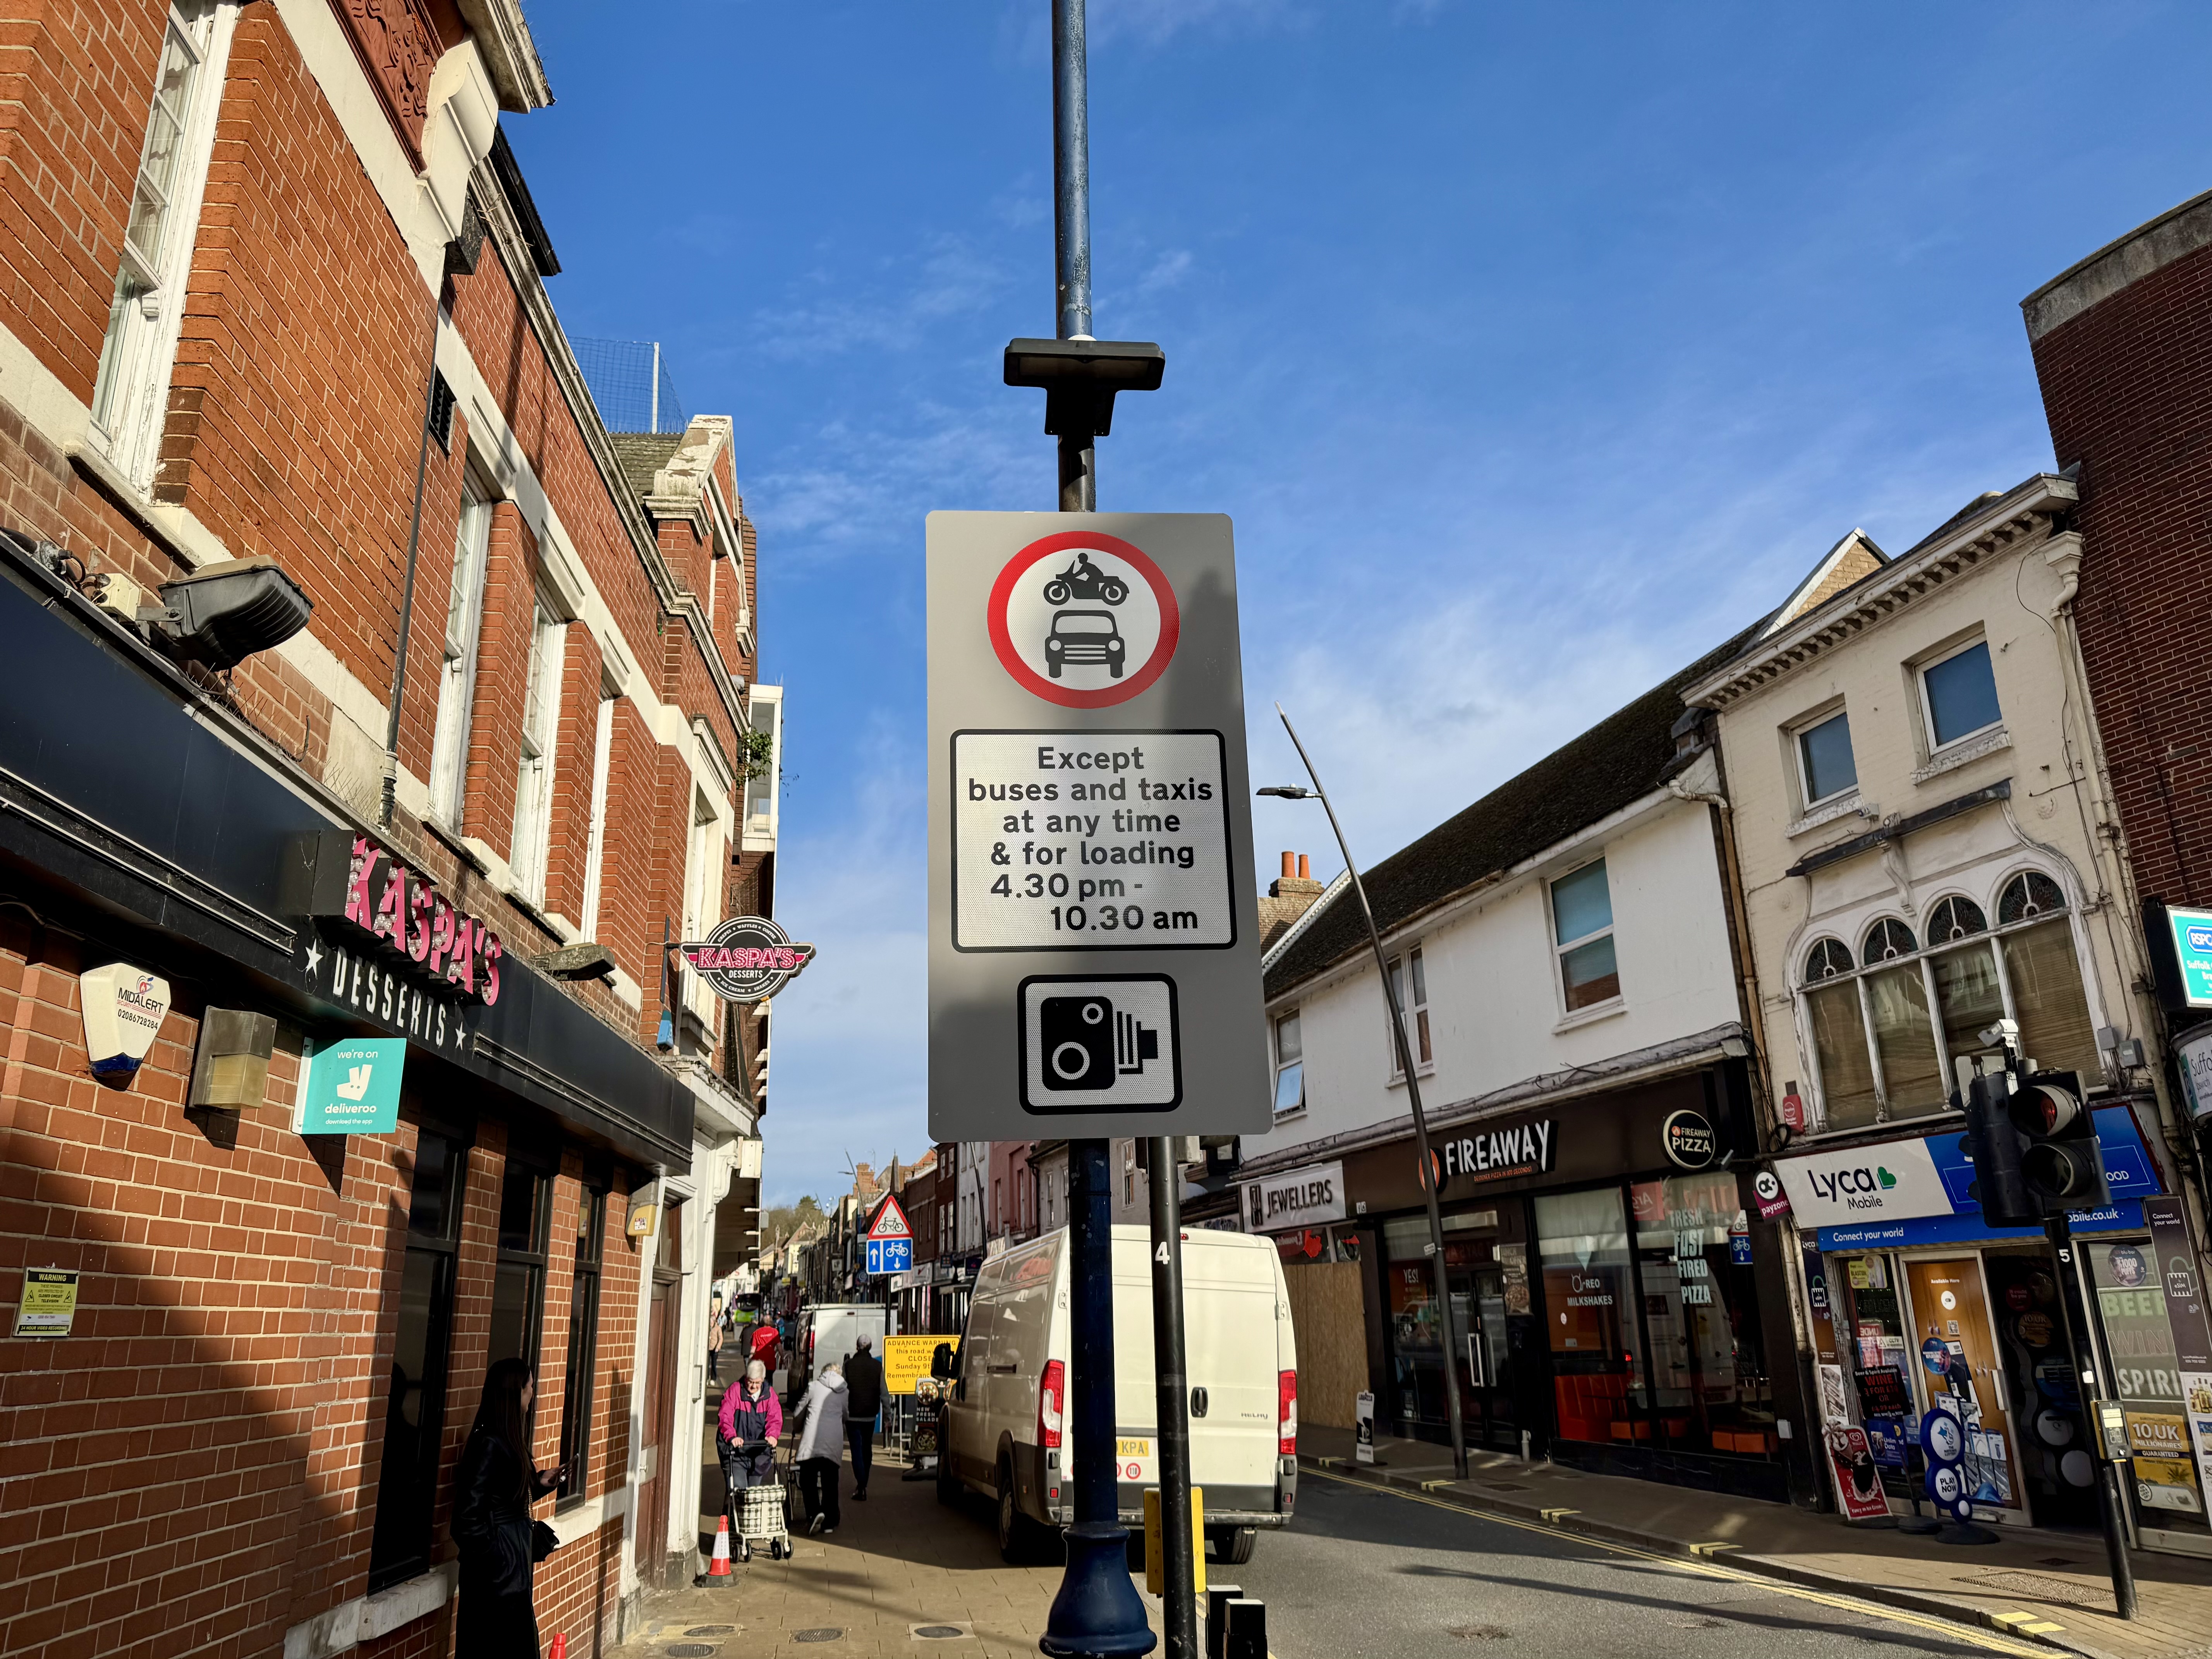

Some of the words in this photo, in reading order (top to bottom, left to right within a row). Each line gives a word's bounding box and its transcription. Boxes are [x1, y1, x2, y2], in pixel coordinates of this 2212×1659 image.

[1037, 747, 1144, 773] Except
[969, 778, 1058, 801] buses
[1071, 778, 1126, 800] and
[1139, 778, 1212, 800] taxis
[1003, 810, 1034, 833] at
[1047, 816, 1100, 837] any
[1113, 809, 1180, 832] time
[991, 842, 1010, 866] &
[1023, 842, 1067, 865] for
[1081, 841, 1194, 869] loading
[990, 873, 1068, 899] 4.30
[1079, 879, 1125, 901] pm
[345, 831, 502, 1006] KASPA'S
[1050, 905, 1144, 931] 10.30
[1153, 910, 1198, 929] am
[2190, 932, 2212, 946] RSPC
[698, 947, 795, 968] KASPA'S
[2187, 960, 2211, 970] Suffolk
[729, 970, 763, 978] DESSERTS
[2202, 971, 2212, 980] Bra
[333, 945, 446, 1046] DESSERTS
[118, 1009, 158, 1030] 02086728284
[337, 1049, 363, 1058] we're
[325, 1103, 376, 1113] deliveroo
[1681, 1127, 1710, 1138] FIREAWAY
[1445, 1119, 1549, 1176] FIREAWAY
[1672, 1137, 1711, 1153] PIZZA
[1807, 1168, 1877, 1202] Lyca
[2106, 1171, 2129, 1181] OOD
[1267, 1179, 1333, 1218] JEWELLERS
[1847, 1195, 1883, 1210] Mobile
[1670, 1207, 1703, 1228] FRESH
[1761, 1200, 1789, 1217] payzone
[1674, 1228, 1704, 1257] FAST
[1833, 1231, 1863, 1242] Connect
[1864, 1232, 1881, 1242] your
[1882, 1227, 1904, 1238] world
[1155, 1242, 1170, 1264] 4
[1802, 1241, 1815, 1249] Lyca
[2058, 1249, 2070, 1262] 5
[1403, 1268, 1419, 1283] YES!
[1677, 1259, 1708, 1278] FIRED
[1567, 1295, 1613, 1306] MILKSHAKES
[1681, 1285, 1712, 1304] PIZZA
[2109, 1329, 2176, 1355] WIN
[1865, 1374, 1893, 1386] WINE
[2118, 1368, 2181, 1396] SPIRI
[2133, 1423, 2152, 1438] 10
[2154, 1425, 2180, 1441] UK
[1122, 1441, 1144, 1454] KPA
[2135, 1439, 2182, 1449] MILLIONAIRES
[1940, 1477, 1955, 1486] PLAY
